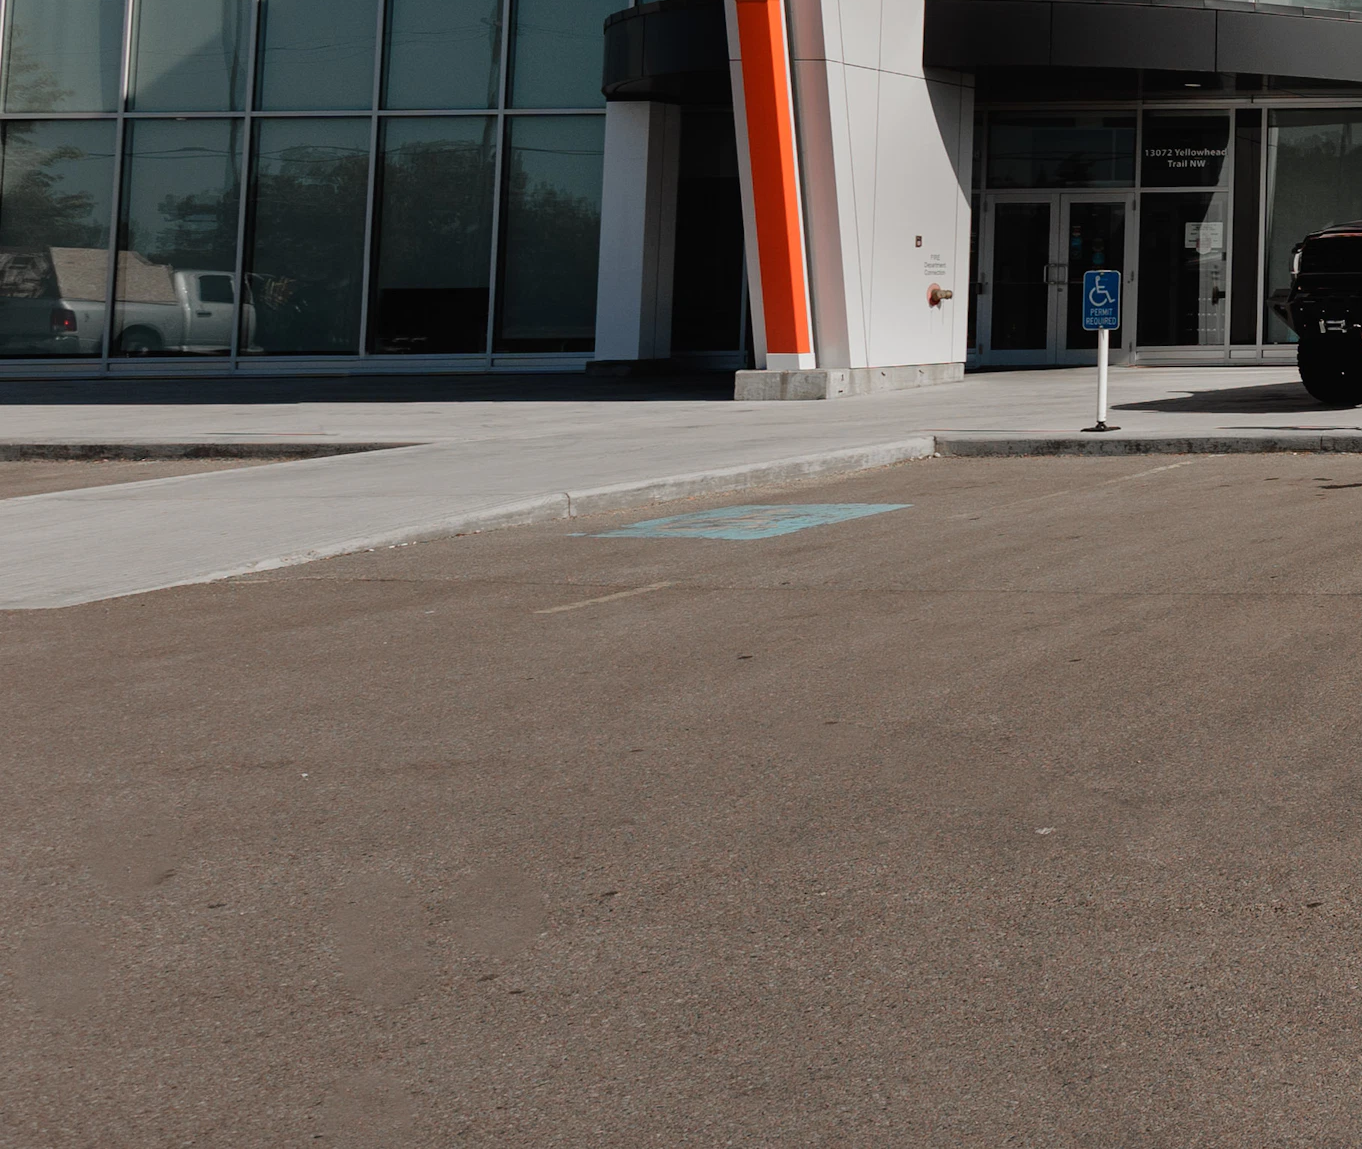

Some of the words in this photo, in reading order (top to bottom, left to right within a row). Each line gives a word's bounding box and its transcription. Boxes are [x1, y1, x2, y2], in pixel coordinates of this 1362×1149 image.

[1175, 148, 1227, 156] Yellowhead
[1090, 308, 1113, 316] PERMIT
[1085, 317, 1117, 325] REQUIRED
